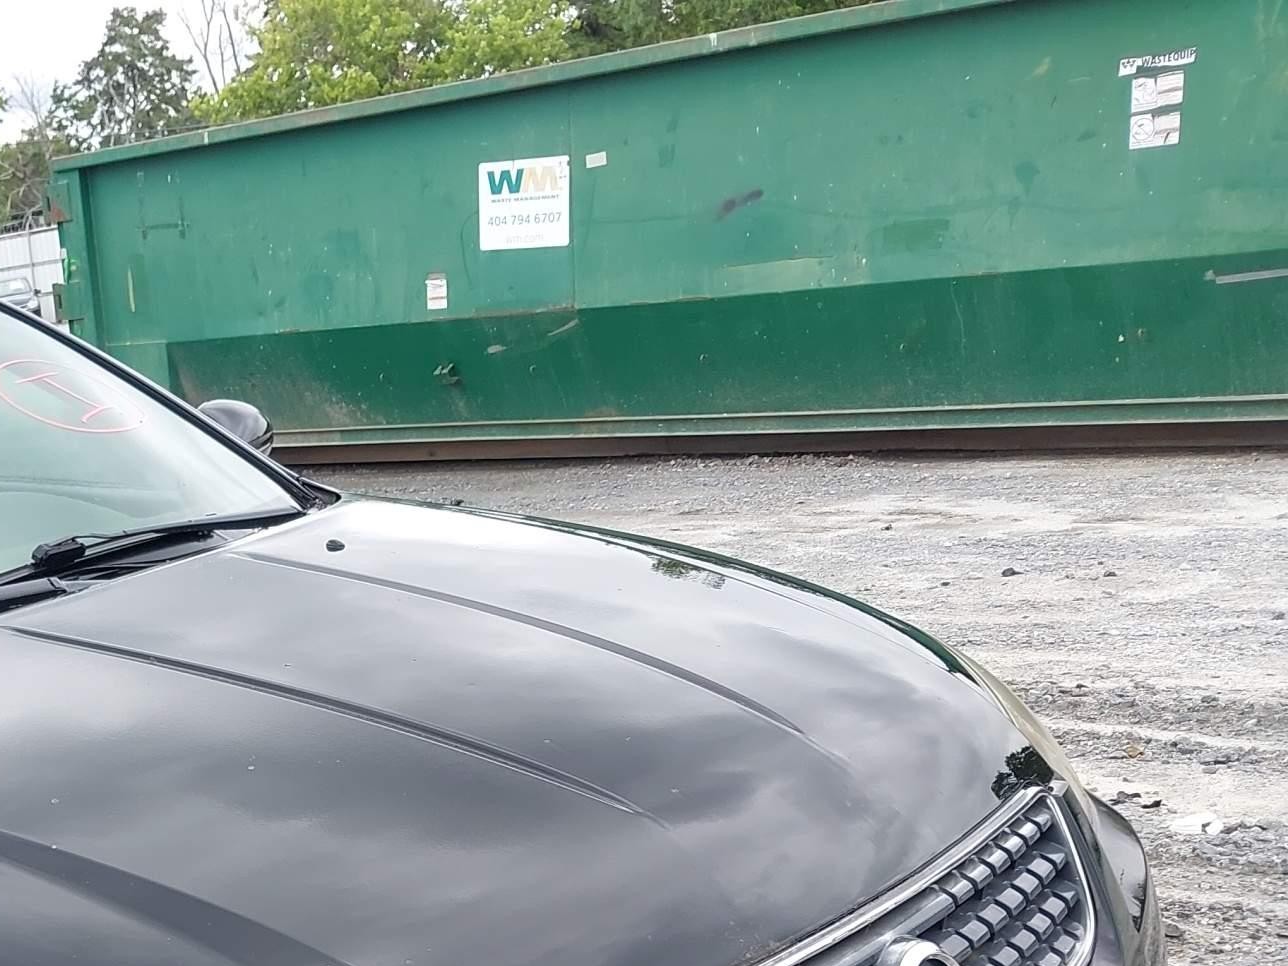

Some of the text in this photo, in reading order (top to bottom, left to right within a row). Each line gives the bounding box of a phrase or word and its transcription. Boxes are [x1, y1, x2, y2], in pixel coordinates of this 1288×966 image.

[1141, 48, 1196, 67] WASTEQUIP
[487, 166, 559, 195] WM
[488, 212, 562, 227] 404 794 6707
